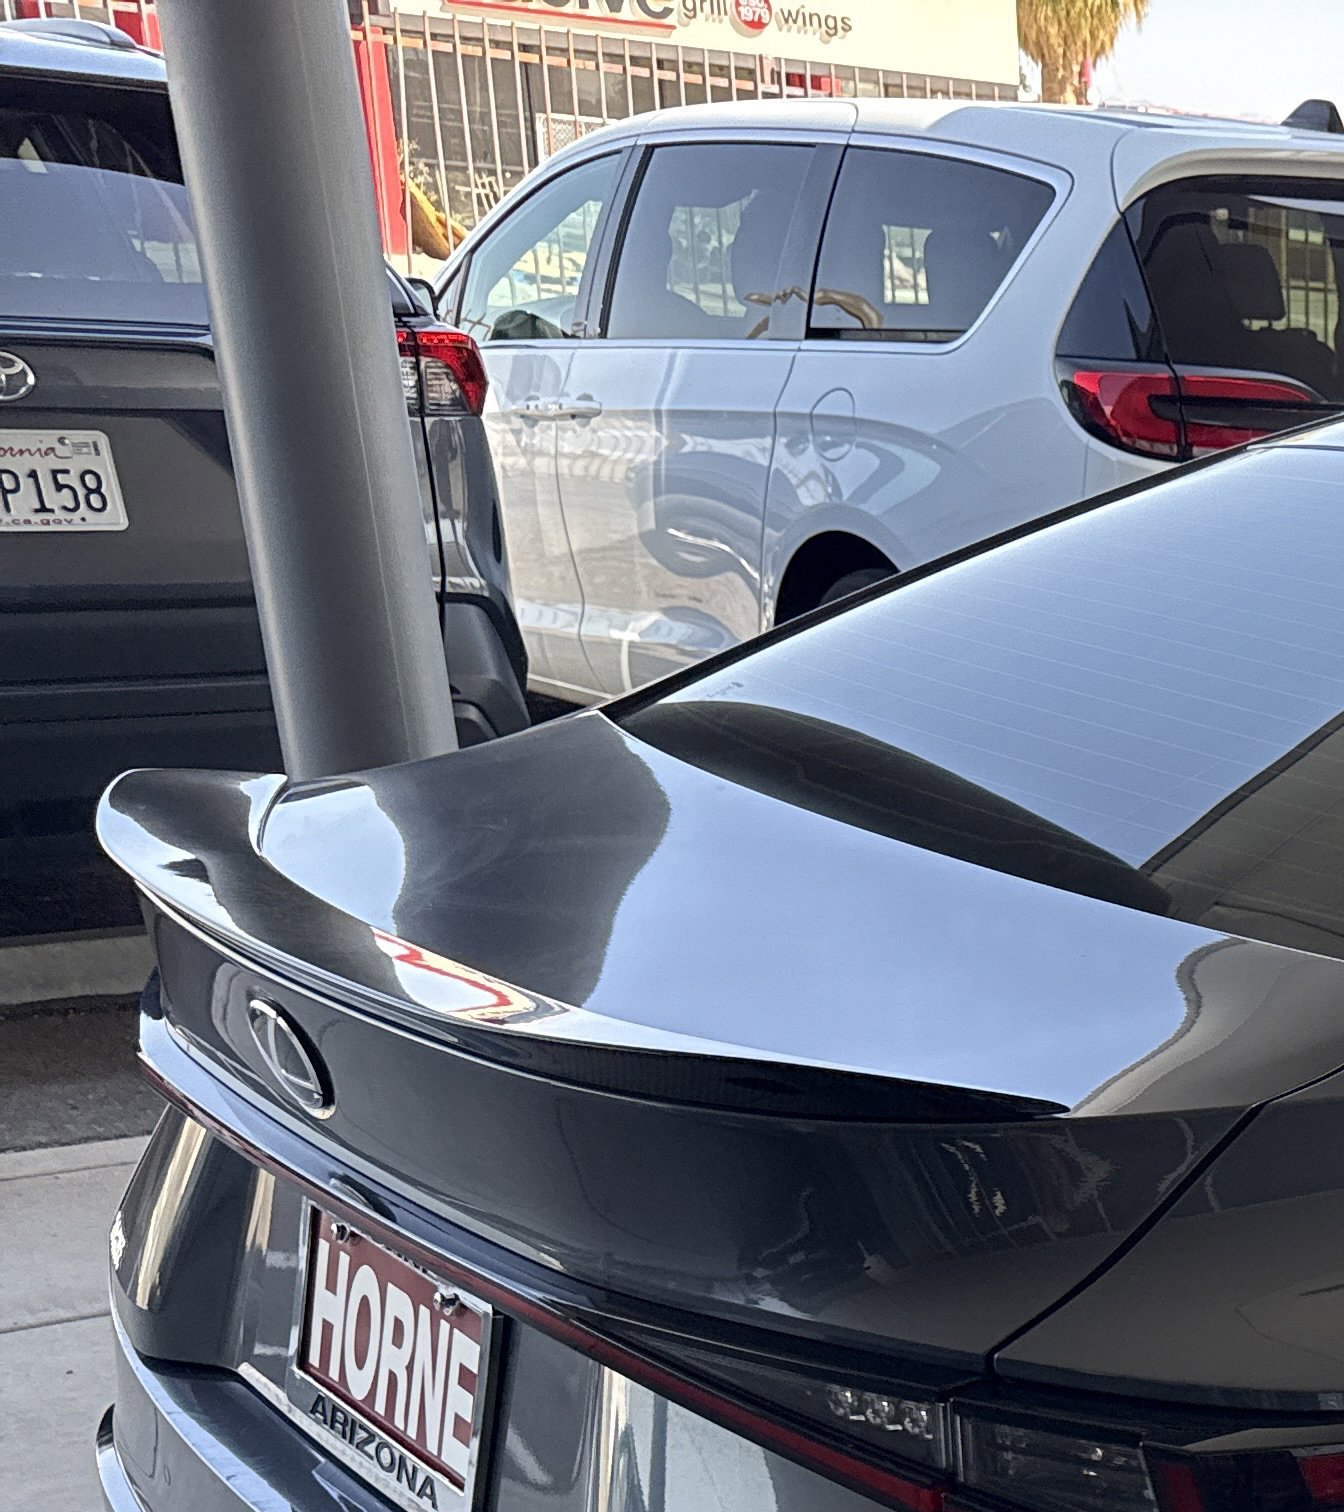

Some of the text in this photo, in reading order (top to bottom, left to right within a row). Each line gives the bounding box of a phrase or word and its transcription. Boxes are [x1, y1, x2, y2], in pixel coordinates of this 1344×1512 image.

[738, 5, 770, 24] 1979
[780, 5, 852, 37] wings
[0, 469, 108, 514] P158
[308, 1238, 481, 1480] HORNE
[309, 1392, 439, 1511] ARIZONA
